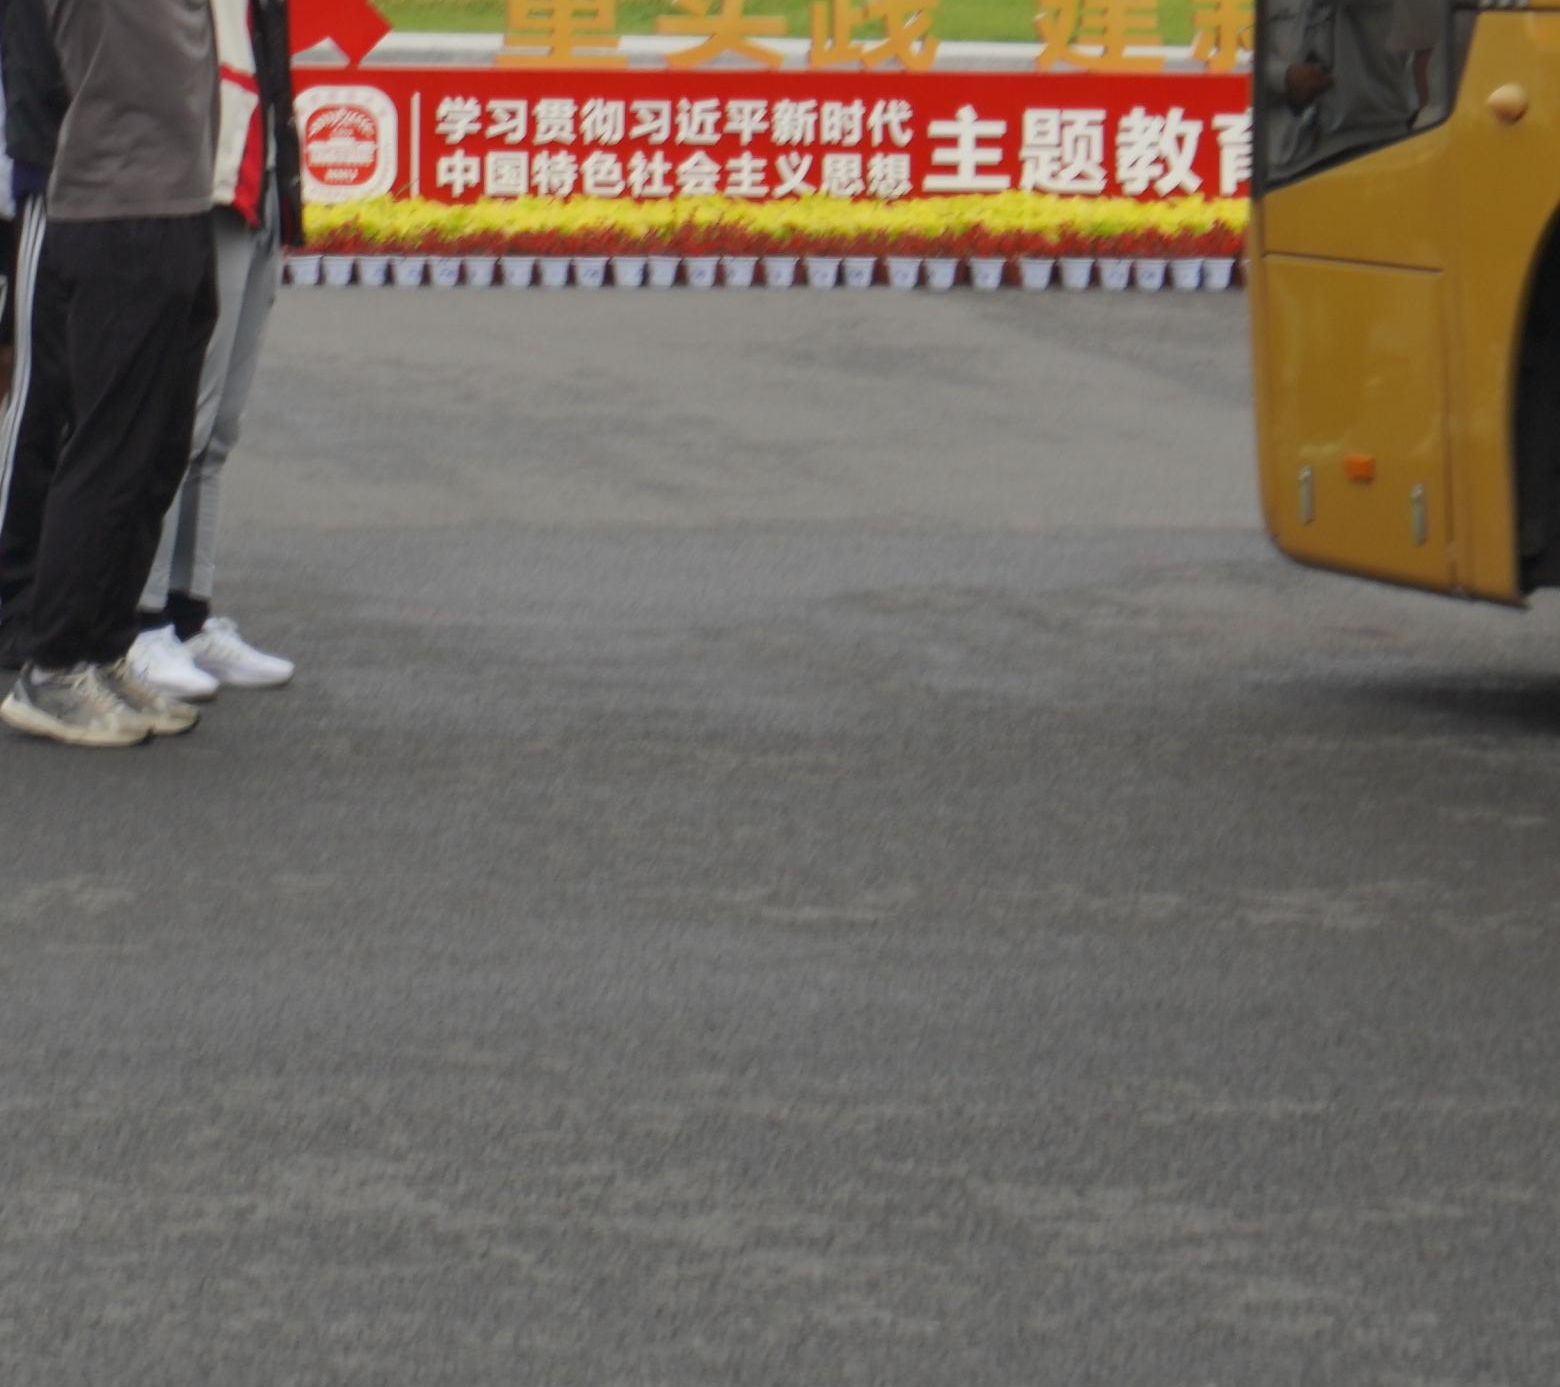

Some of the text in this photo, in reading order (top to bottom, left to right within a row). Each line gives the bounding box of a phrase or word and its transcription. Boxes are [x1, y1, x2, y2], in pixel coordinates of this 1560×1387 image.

[435, 96, 914, 146] 学习贯彻习近平新时代
[436, 148, 913, 198] 中国特色社会主义思想
